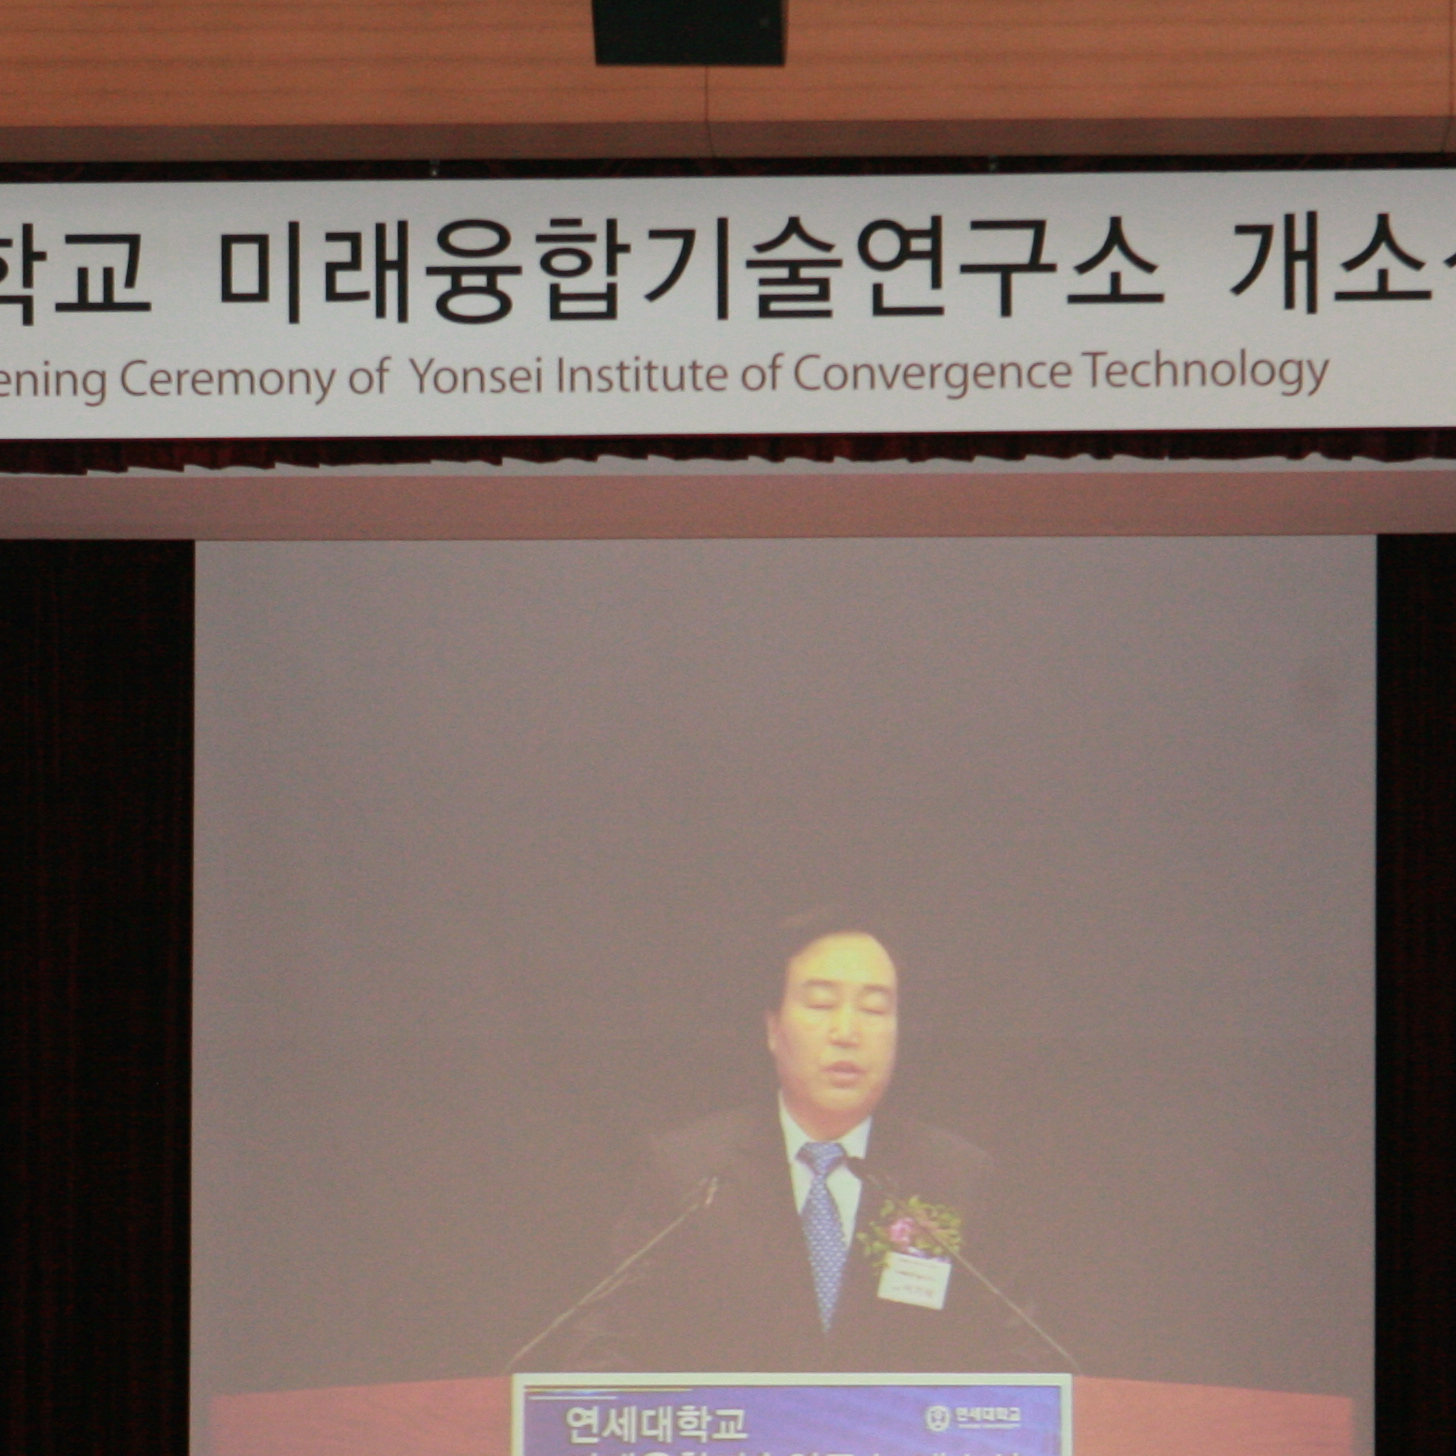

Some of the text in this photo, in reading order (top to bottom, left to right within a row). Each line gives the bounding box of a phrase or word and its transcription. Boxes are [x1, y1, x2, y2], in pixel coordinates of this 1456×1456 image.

[219, 213, 1166, 326] 미래융합기술연구소
[119, 358, 337, 406] Ceremony
[347, 355, 393, 396] of
[408, 355, 543, 395] Yonsei
[557, 355, 729, 394] Institute
[740, 351, 785, 392] of
[793, 353, 1073, 401] Convergence
[1080, 347, 1331, 398] Technology
[565, 1404, 749, 1443] 연세대학교
